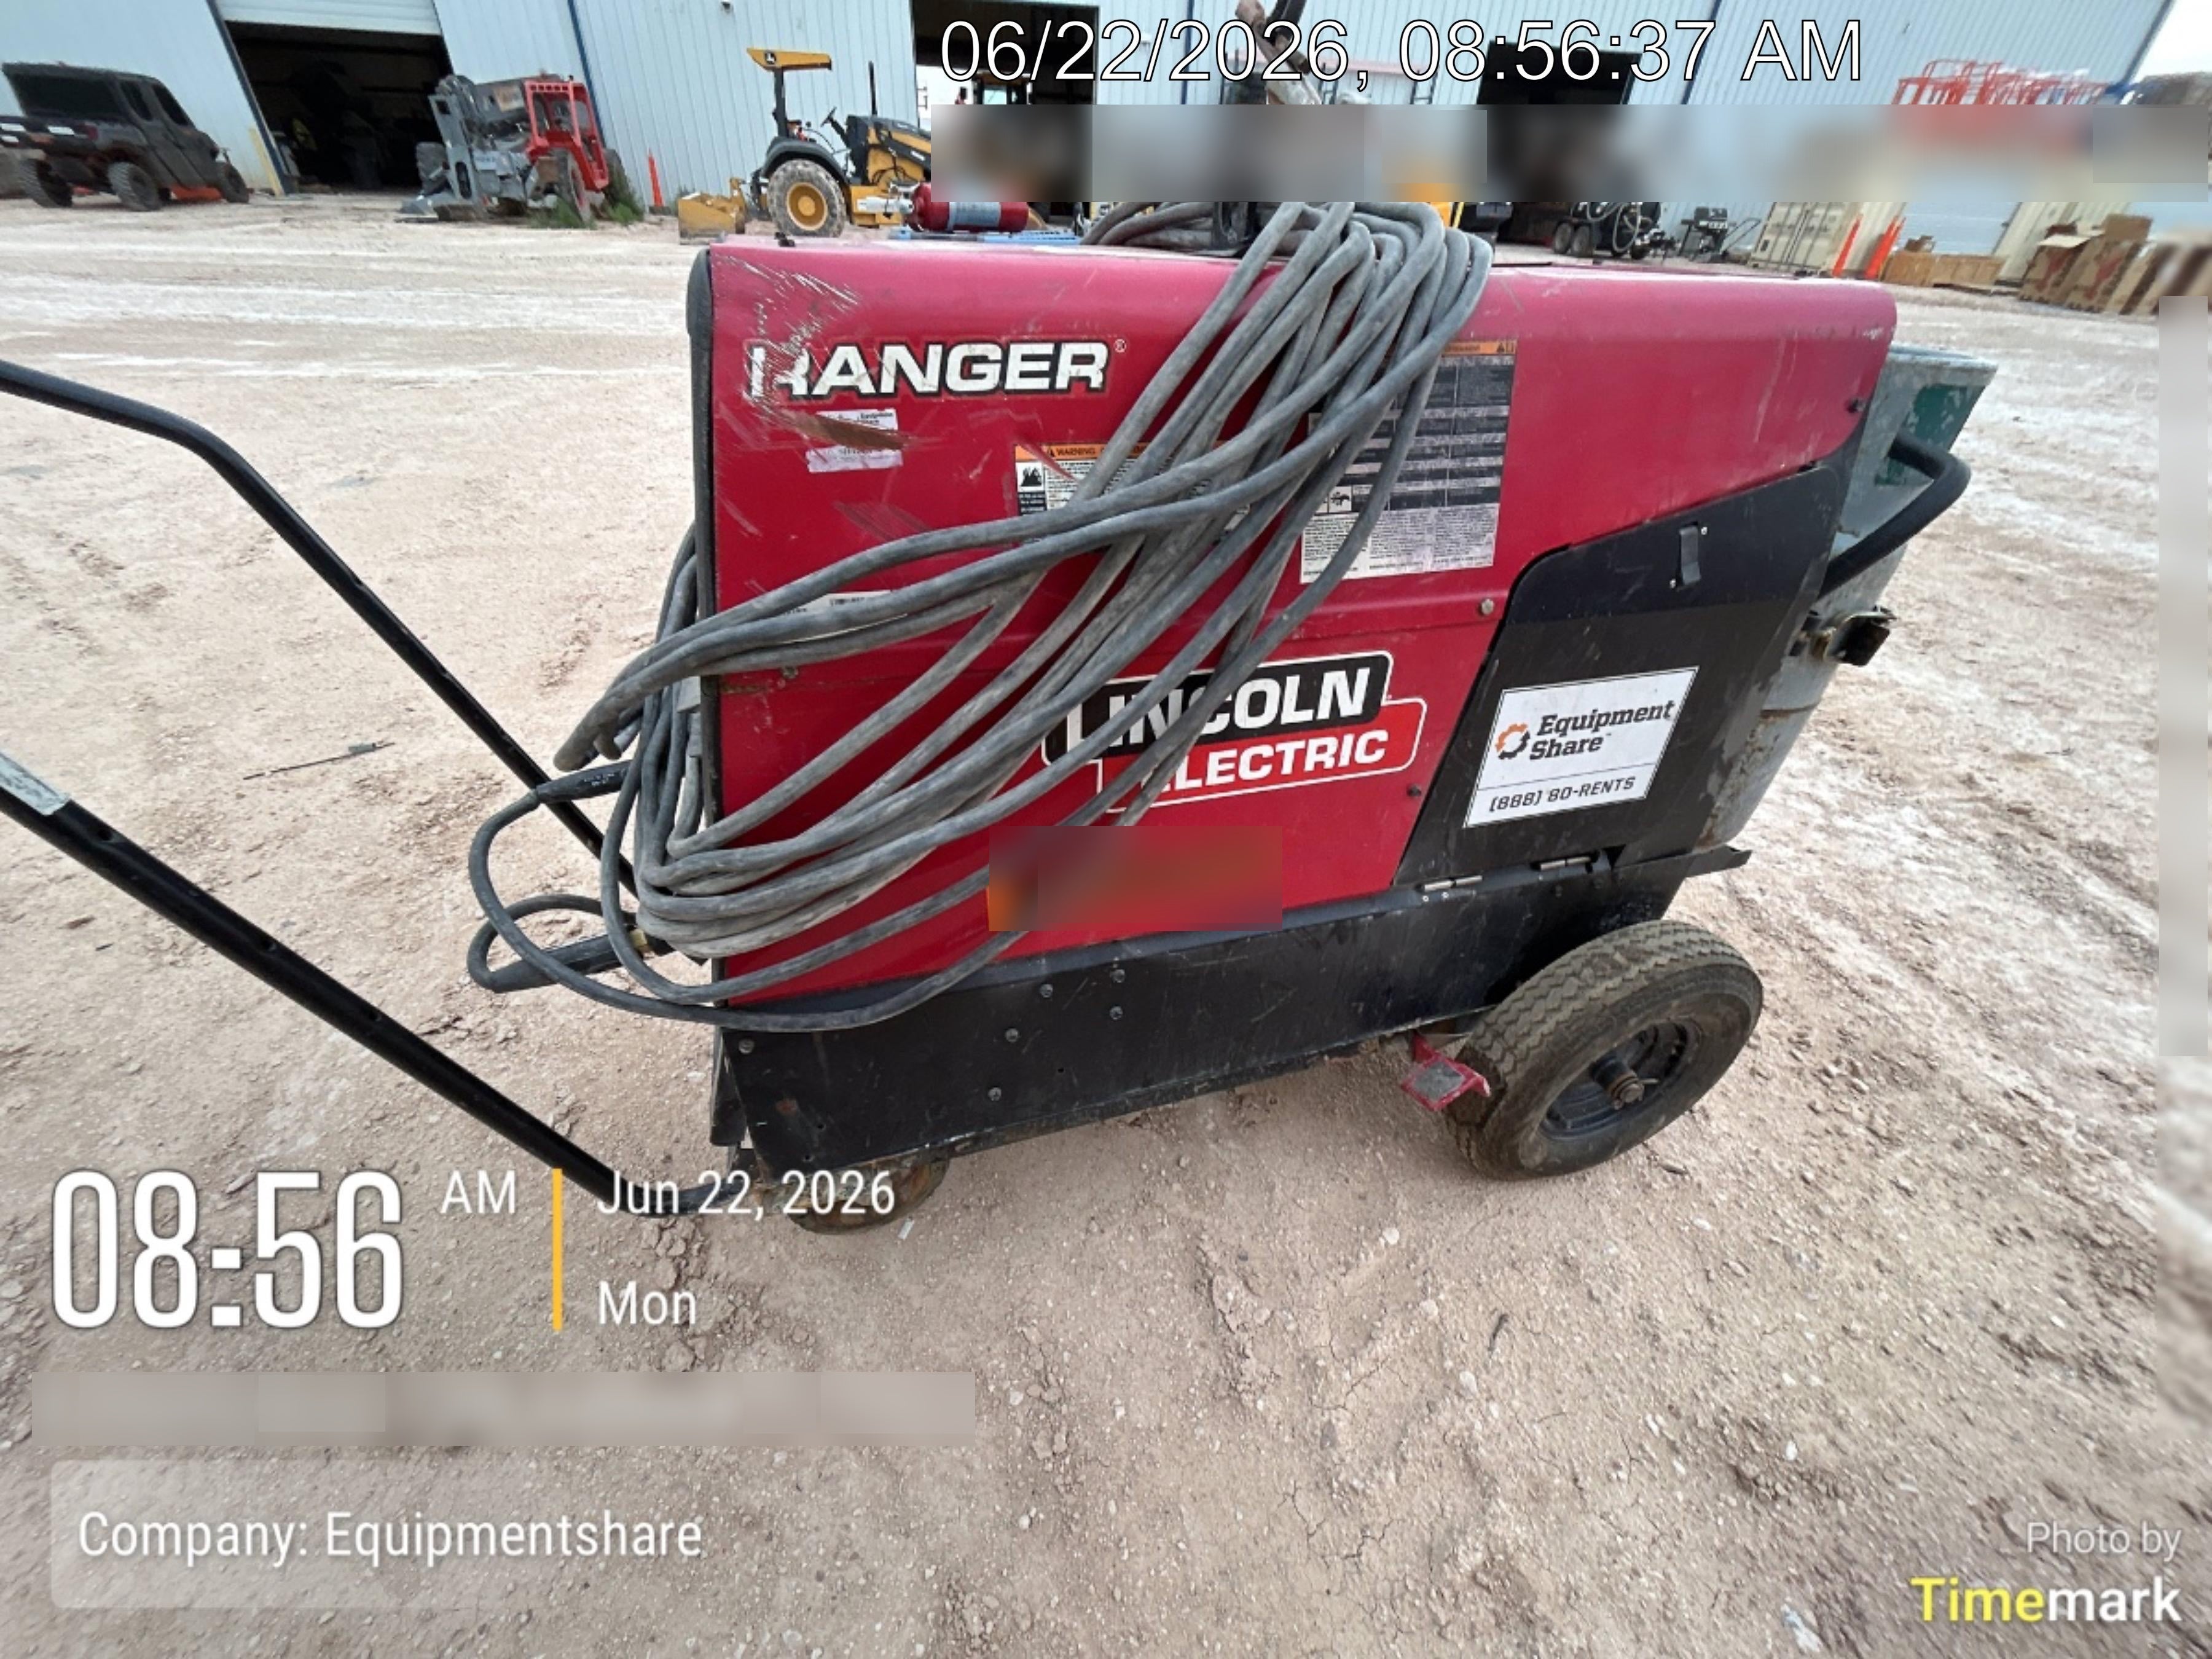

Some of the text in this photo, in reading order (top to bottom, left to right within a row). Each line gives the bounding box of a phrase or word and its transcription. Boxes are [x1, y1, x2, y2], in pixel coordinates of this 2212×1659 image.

[750, 342, 1108, 397] RANGER
[1536, 700, 1676, 737] Equipment
[1140, 729, 1388, 791] LECTRIC
[1529, 735, 1604, 760] Share
[1489, 776, 1636, 812] (888) 80-RENTS
